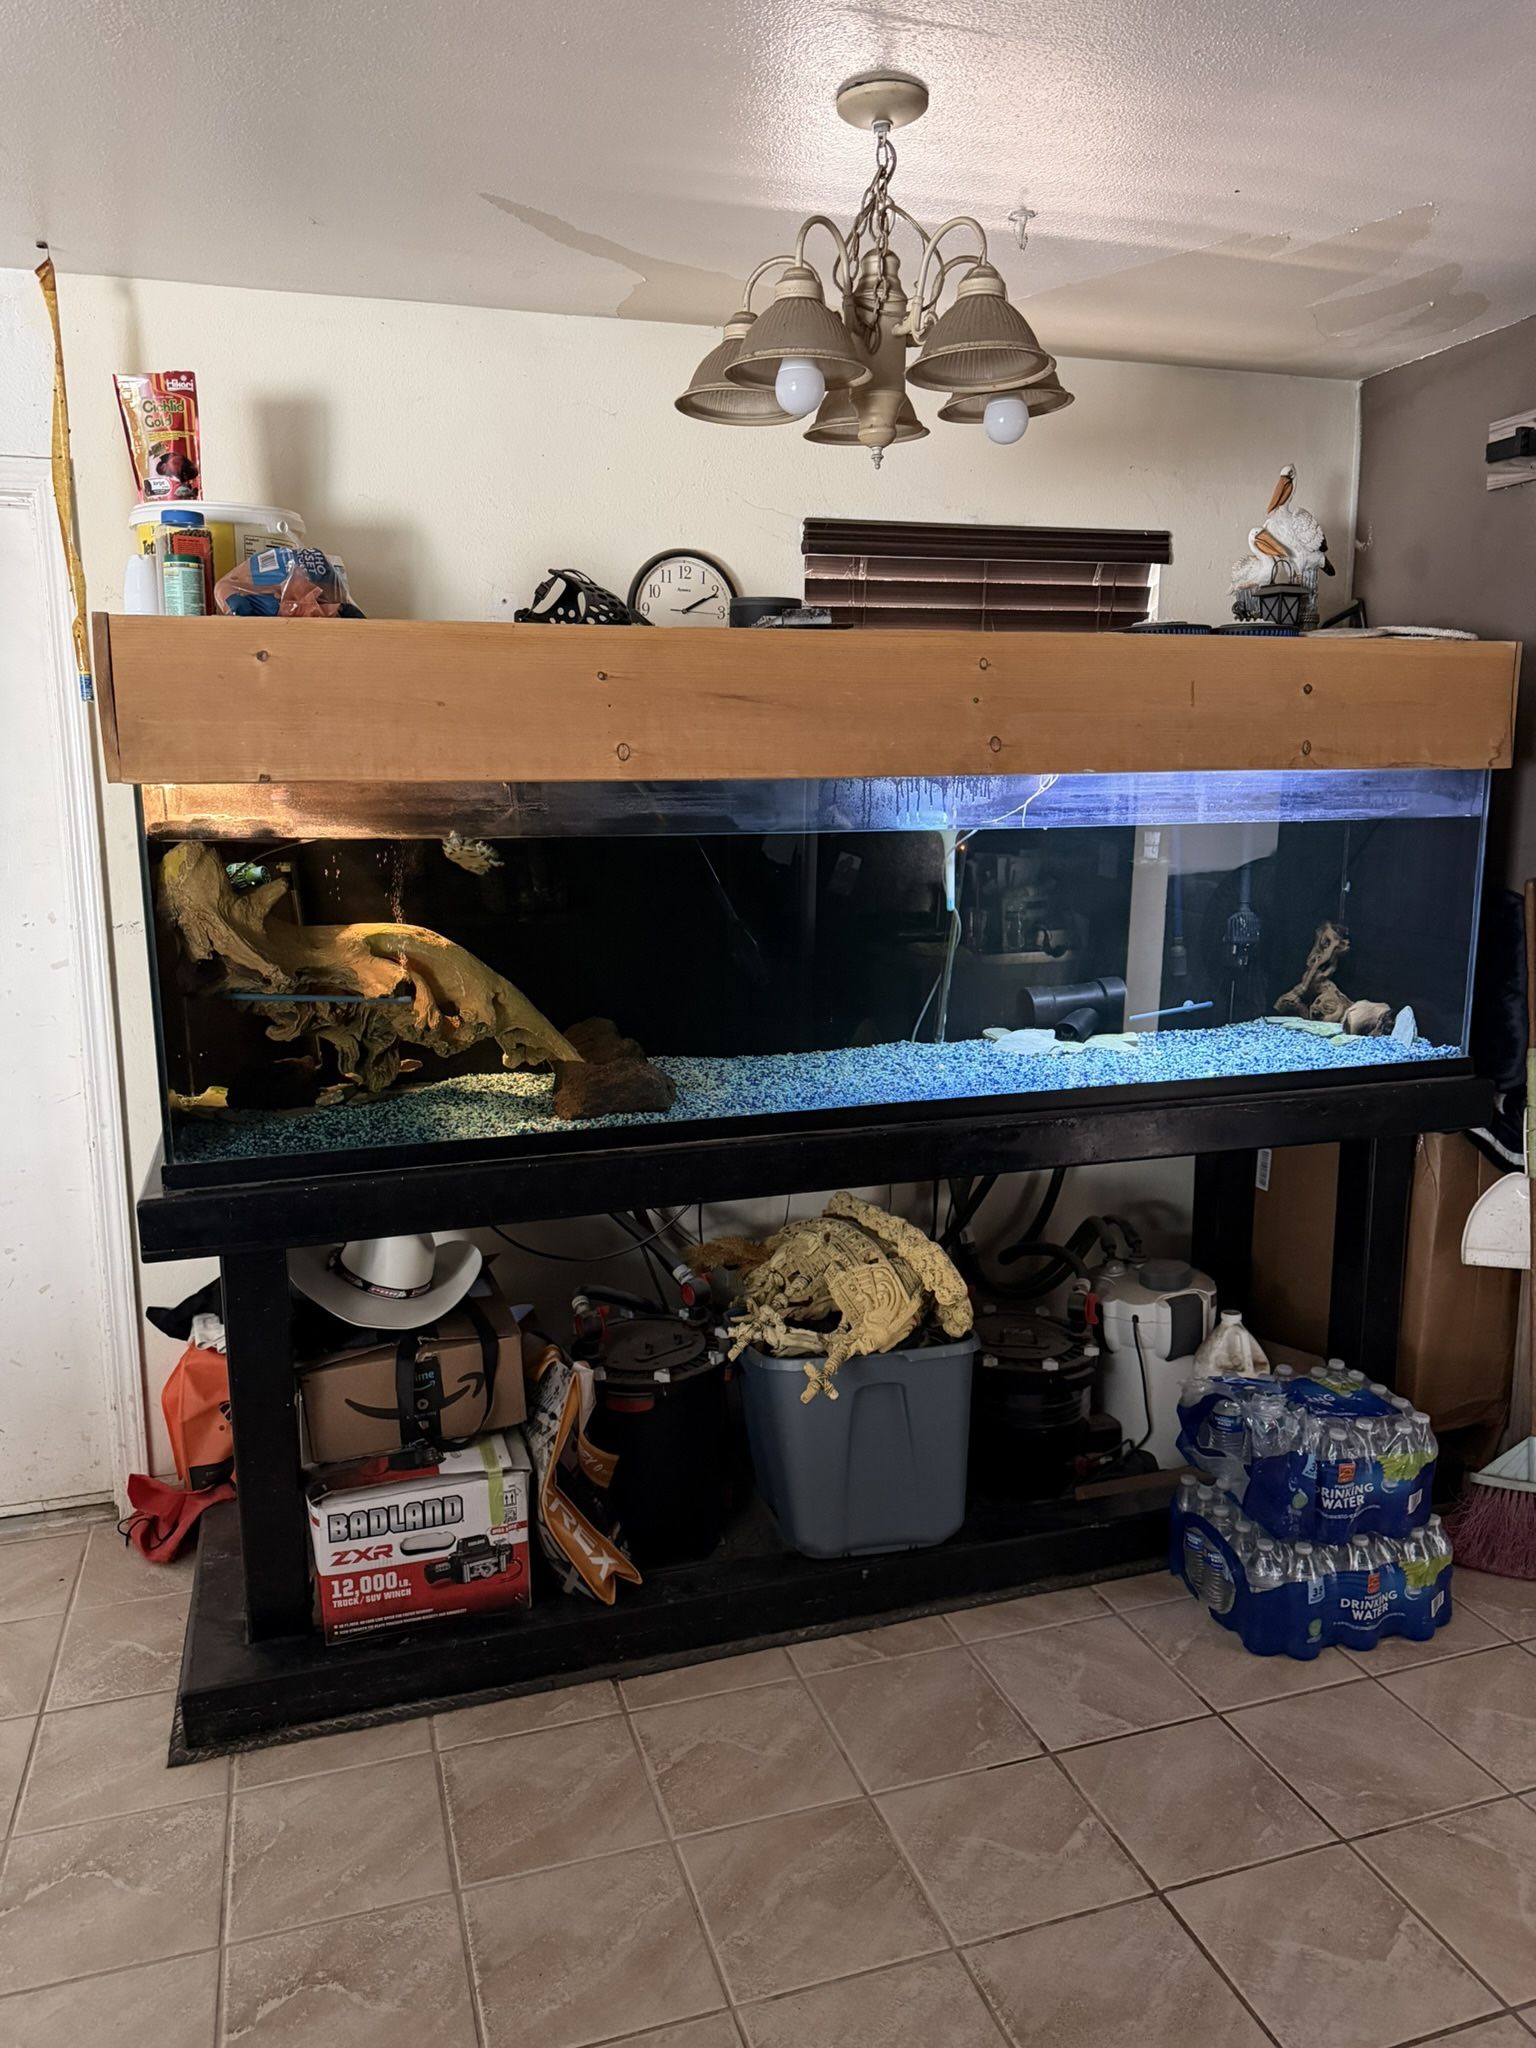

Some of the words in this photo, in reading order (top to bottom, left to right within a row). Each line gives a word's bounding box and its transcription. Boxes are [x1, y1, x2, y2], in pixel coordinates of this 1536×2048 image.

[143, 399, 185, 412] Cichlid
[145, 415, 172, 428] Gold
[661, 569, 671, 583] 11
[679, 566, 692, 579] 12
[701, 571, 705, 584] 1
[649, 584, 661, 598] 10
[711, 585, 719, 599] 2
[641, 602, 650, 616] 9
[717, 605, 726, 620] 3
[1322, 1495, 1365, 1510] WATER
[327, 1495, 463, 1543] BADLAND
[330, 1543, 393, 1567] ZXR
[331, 1571, 398, 1599] 12,000
[384, 1588, 412, 1600] WINCH
[1340, 1590, 1398, 1611] DRINKING
[1351, 1602, 1388, 1621] WATER
